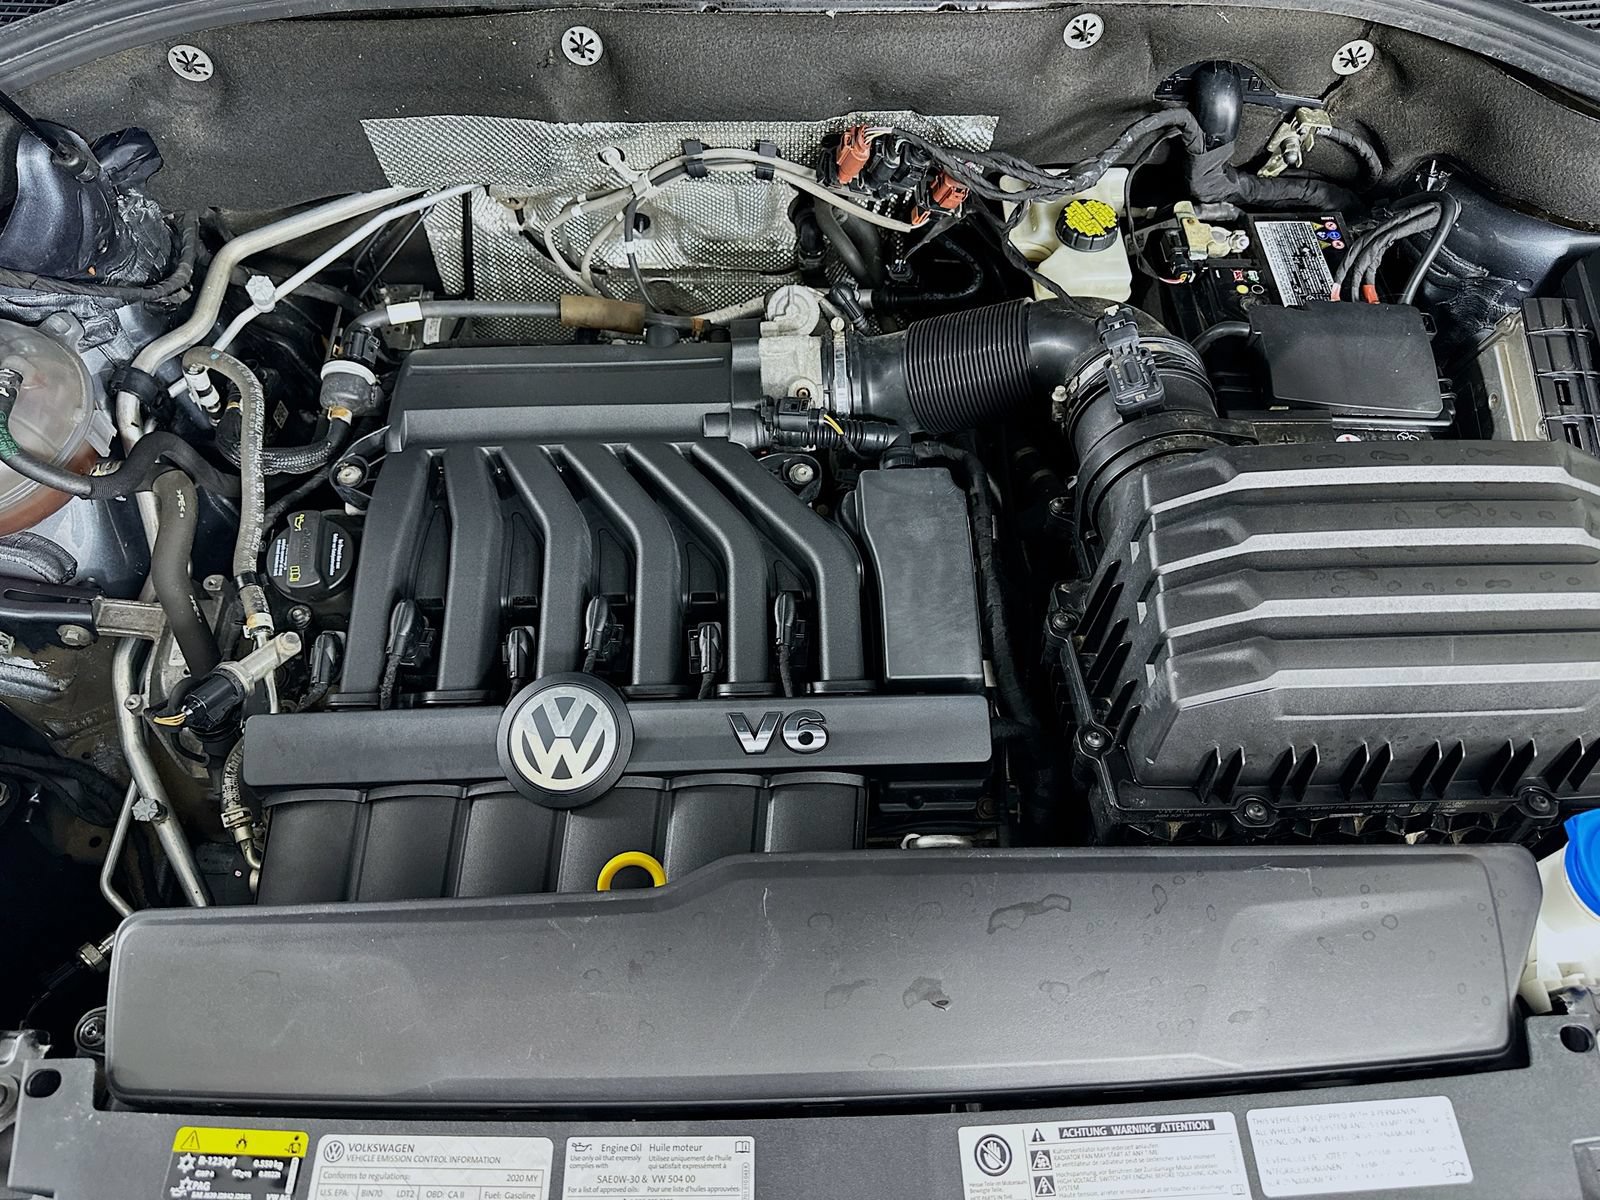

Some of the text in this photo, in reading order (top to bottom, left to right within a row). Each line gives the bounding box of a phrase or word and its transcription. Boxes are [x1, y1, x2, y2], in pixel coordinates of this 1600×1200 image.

[726, 709, 829, 755] V6
[509, 685, 617, 791] VW
[1062, 1120, 1210, 1138] ACHTUNG WARNING ATTENTION
[348, 1143, 415, 1153] VOLKSWAGEN
[601, 1143, 703, 1154] Engine Oil Huile moteur
[346, 1154, 501, 1164] VEHICLE EMISSION CONTROL INFORMATION
[323, 1171, 357, 1180] Conforms
[359, 1171, 366, 1180] to
[506, 1174, 538, 1182] 2020 MY
[641, 1175, 648, 1184] &
[651, 1175, 666, 1183] VW
[668, 1175, 683, 1183] 504
[685, 1175, 696, 1183] 00
[396, 1190, 415, 1198] LDT2
[505, 1192, 536, 1200] Gasoline
